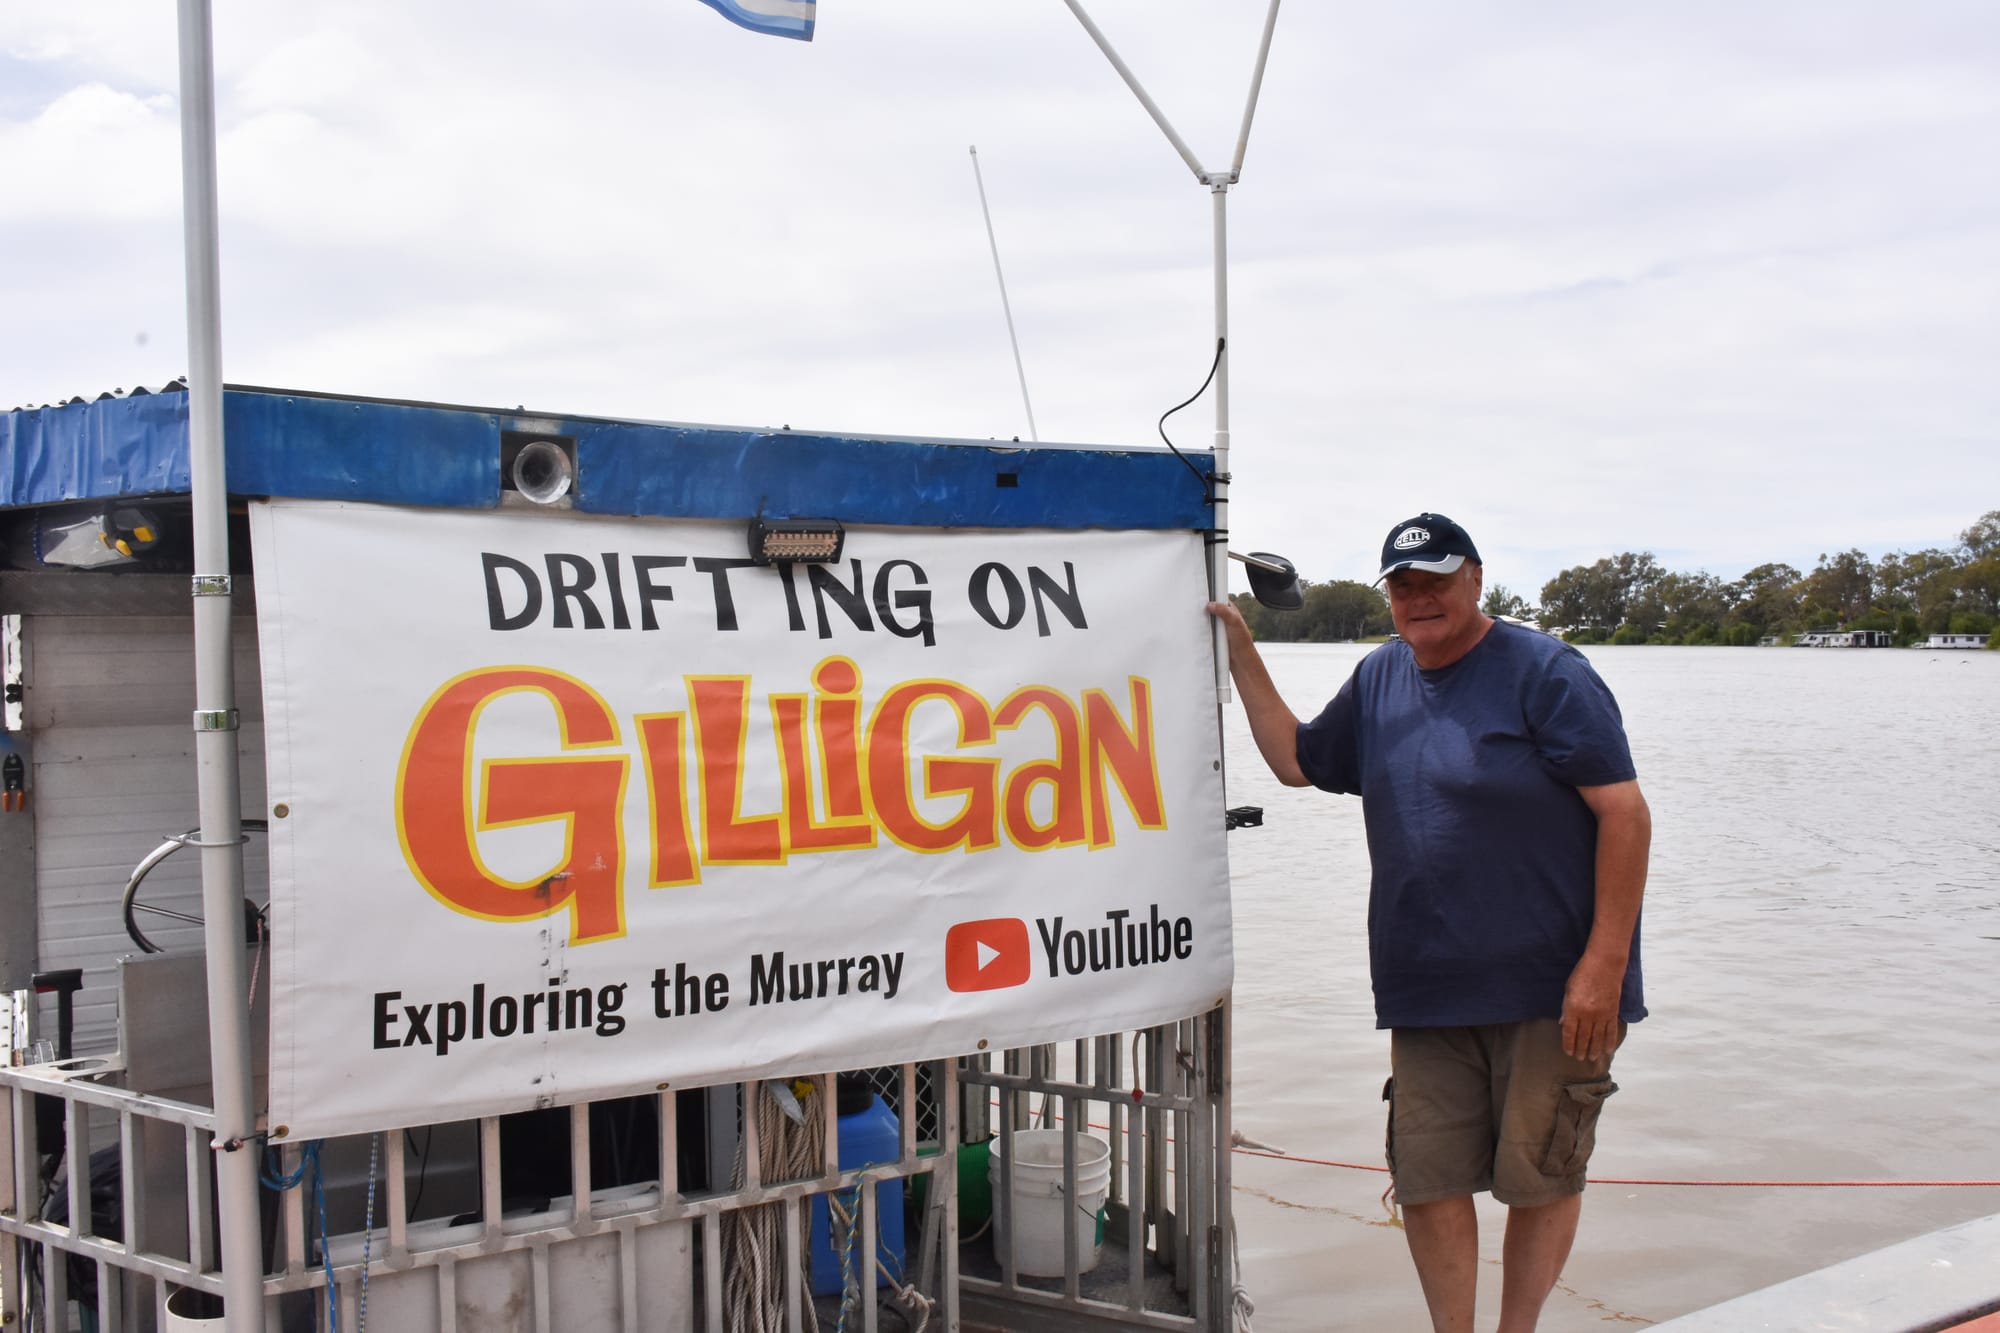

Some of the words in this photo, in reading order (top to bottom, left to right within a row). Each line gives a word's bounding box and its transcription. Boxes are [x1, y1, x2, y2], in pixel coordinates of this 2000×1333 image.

[481, 552, 936, 648] DRIFTING
[967, 560, 1089, 637] ON
[1036, 904, 1194, 977] YouTube
[373, 977, 628, 1056] Exploring
[651, 962, 730, 1019] the
[748, 950, 904, 1006] Murray
